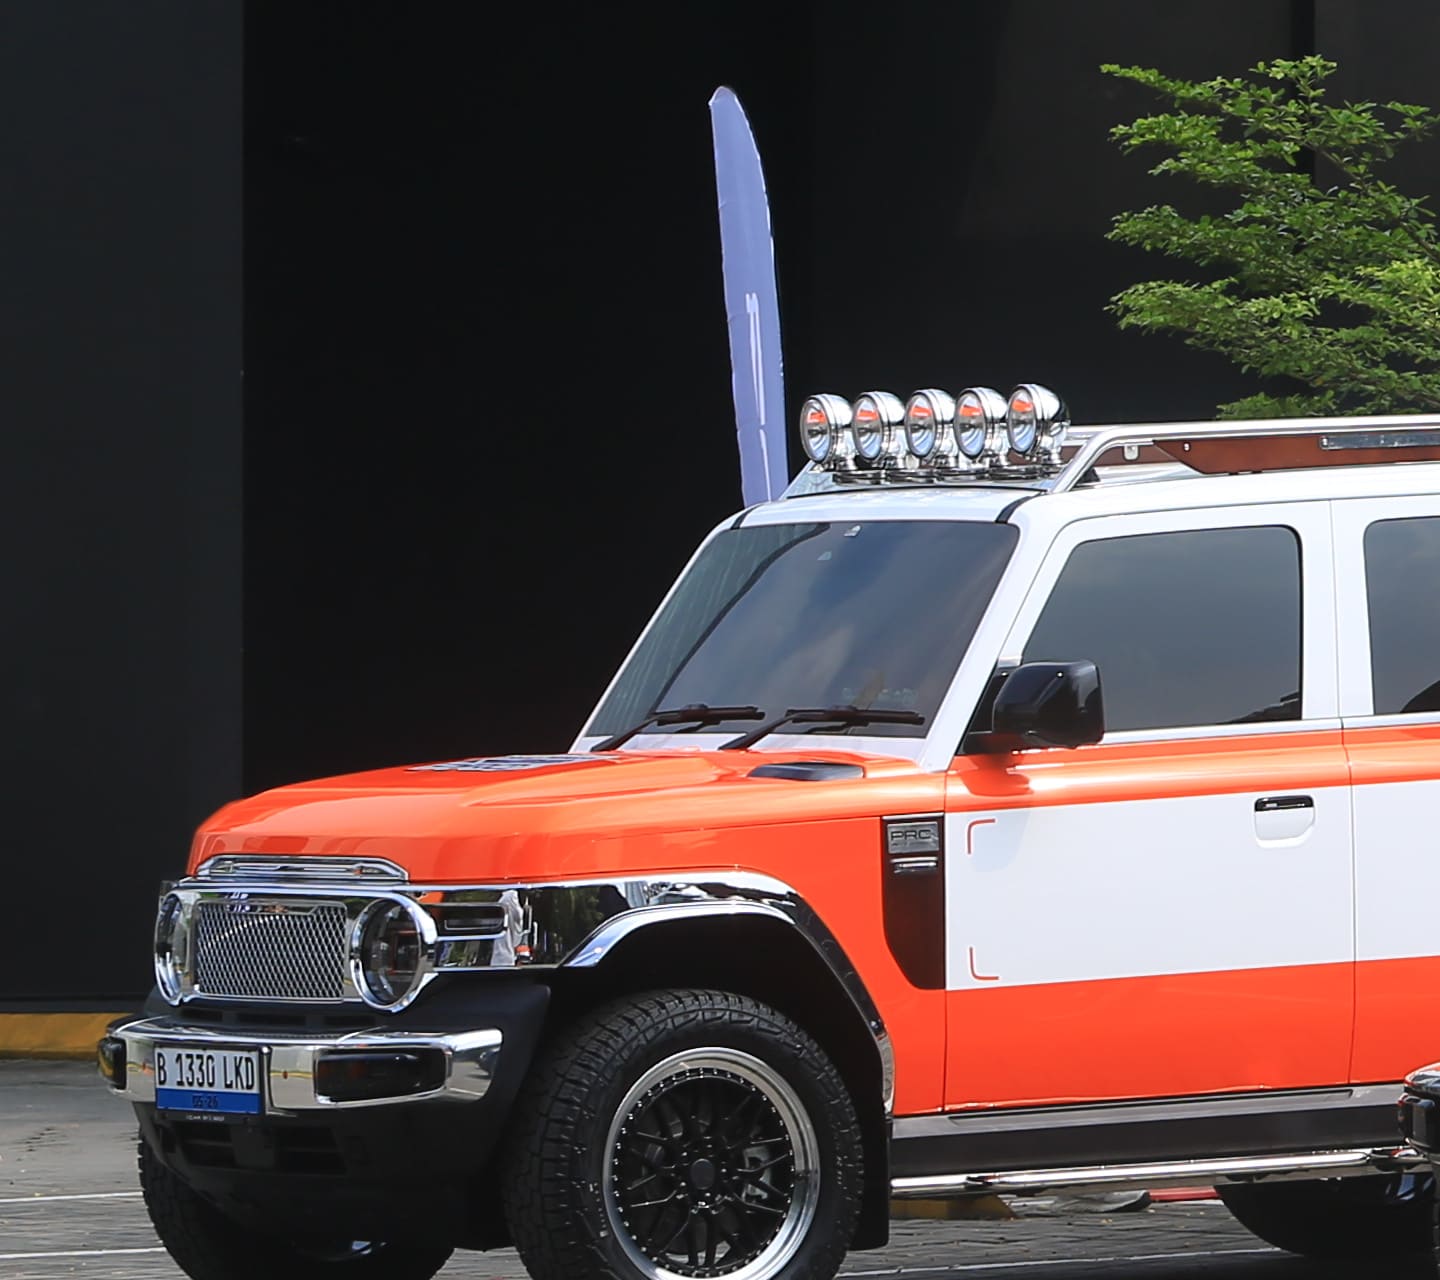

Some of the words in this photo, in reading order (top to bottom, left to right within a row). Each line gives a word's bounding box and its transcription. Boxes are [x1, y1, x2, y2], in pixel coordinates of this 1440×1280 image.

[157, 1052, 167, 1086] B
[175, 1053, 216, 1088] 1330
[223, 1055, 255, 1090] LKD
